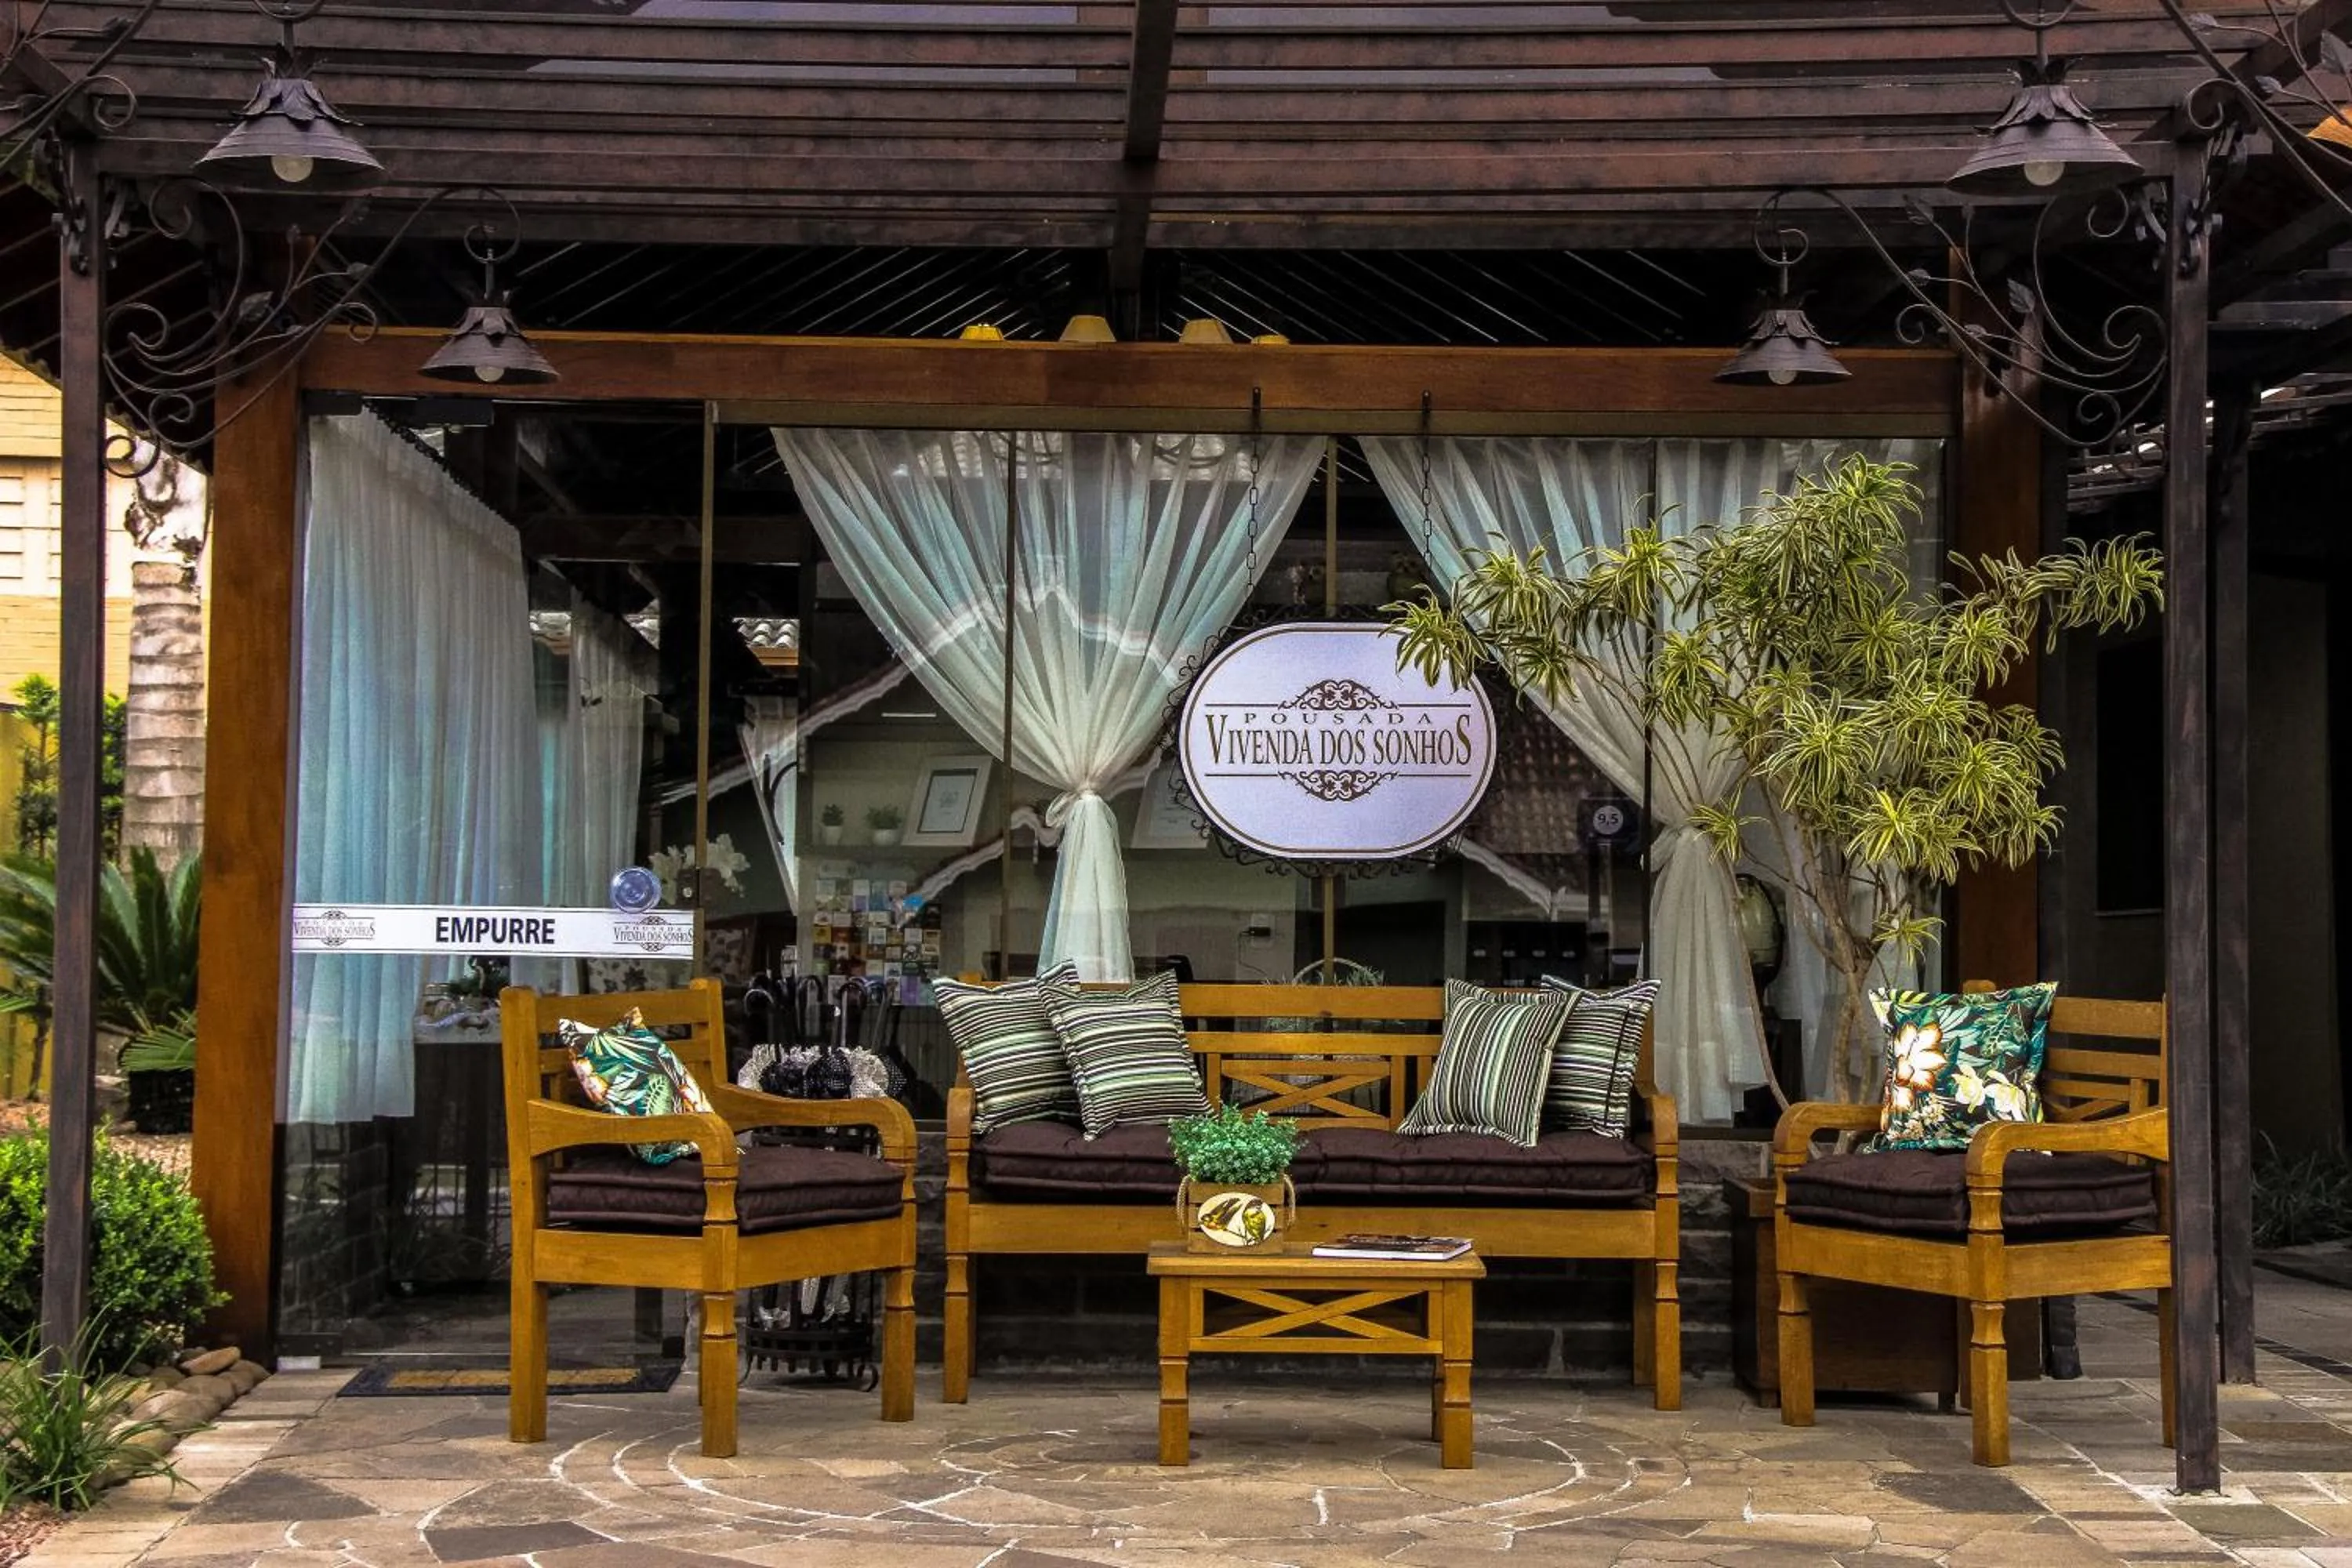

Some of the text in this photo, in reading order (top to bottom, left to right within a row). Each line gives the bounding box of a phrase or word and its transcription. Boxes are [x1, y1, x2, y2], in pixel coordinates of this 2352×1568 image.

[1244, 713, 1432, 724] POUSADA
[1206, 714, 1472, 766] VIVENDA DOS SONHOS
[436, 916, 556, 944] EMPURRE
